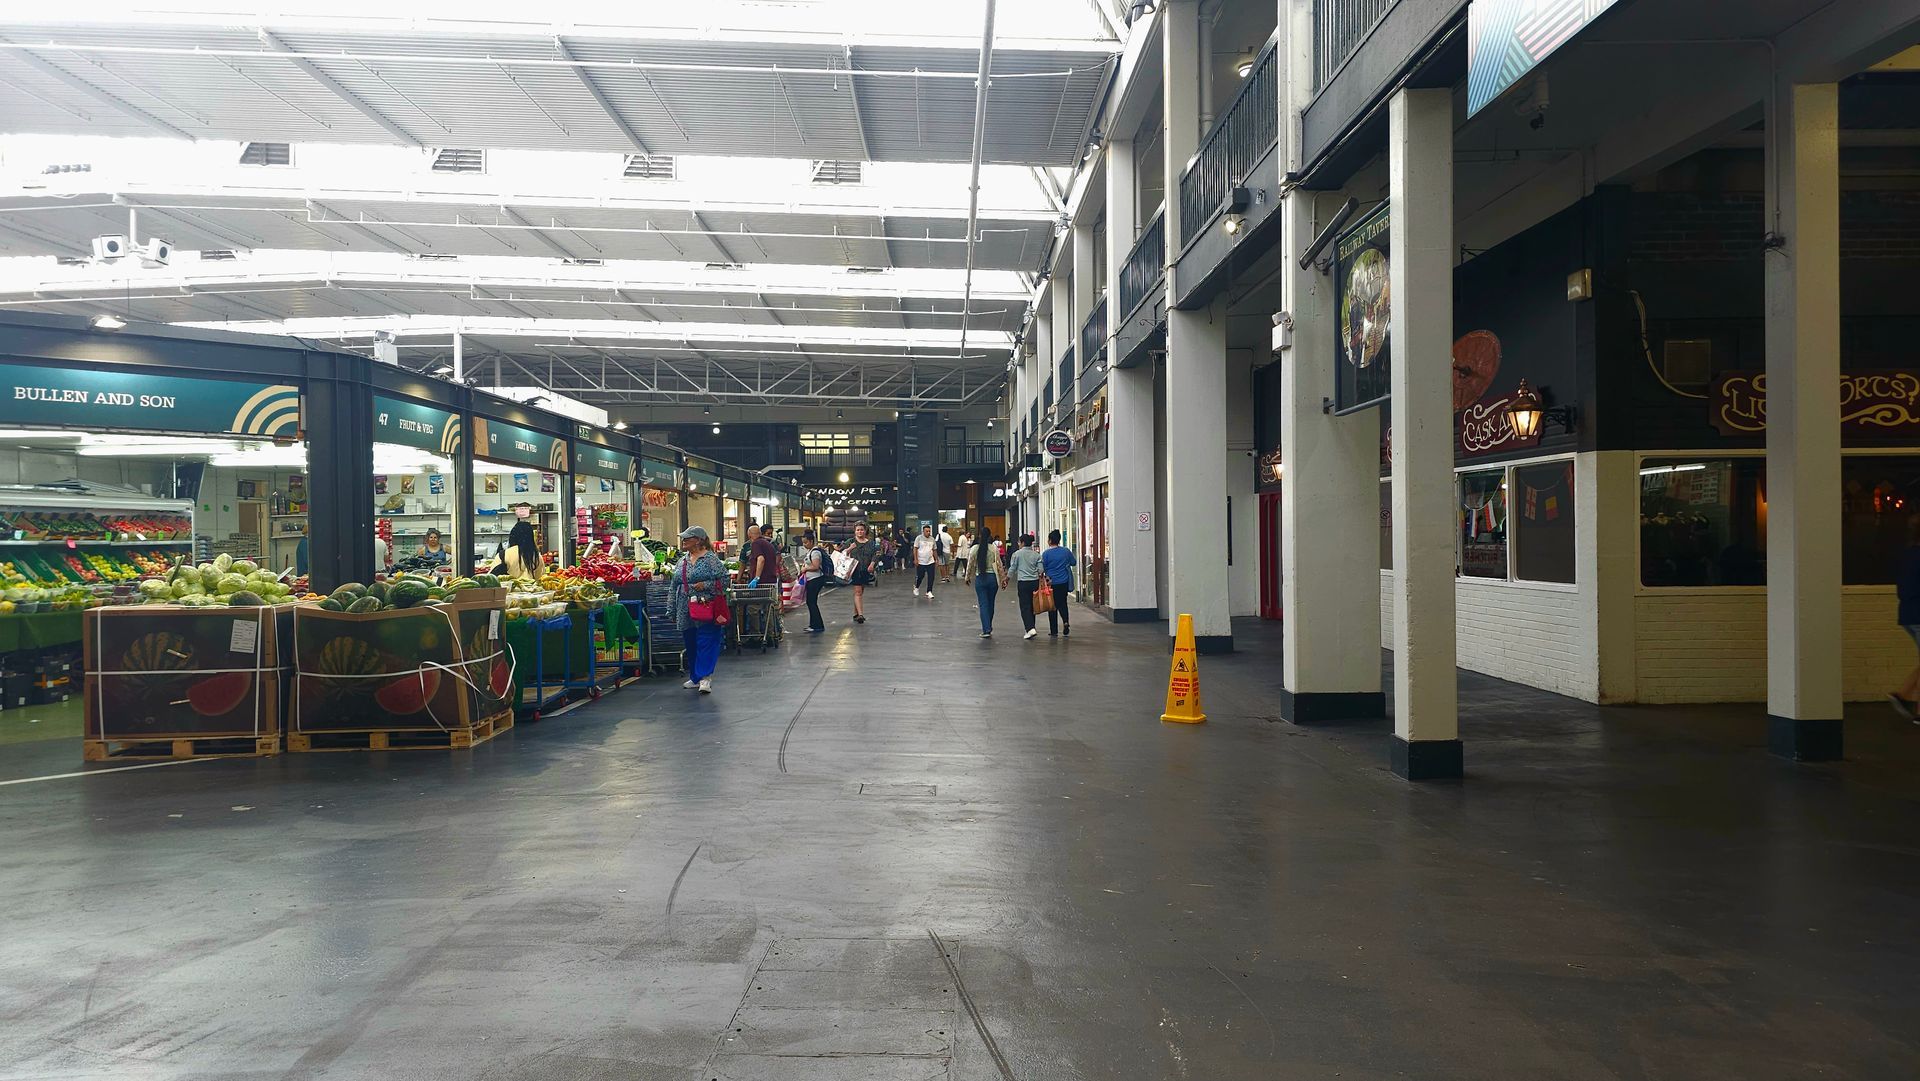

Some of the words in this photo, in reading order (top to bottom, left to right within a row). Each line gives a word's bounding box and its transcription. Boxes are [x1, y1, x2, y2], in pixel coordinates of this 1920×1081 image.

[1339, 232, 1366, 261] RAILWAY
[1366, 214, 1391, 241] TAVER
[14, 386, 89, 403] BULLEN
[94, 392, 135, 406] AND
[140, 395, 176, 409] SON
[378, 412, 389, 426] 47
[399, 418, 416, 432] FRUIT
[416, 422, 422, 432] &
[422, 423, 434, 434] VEG
[1466, 414, 1497, 442] CASK
[490, 433, 497, 444] 47
[817, 487, 855, 495] NDON
[860, 487, 883, 495] PET
